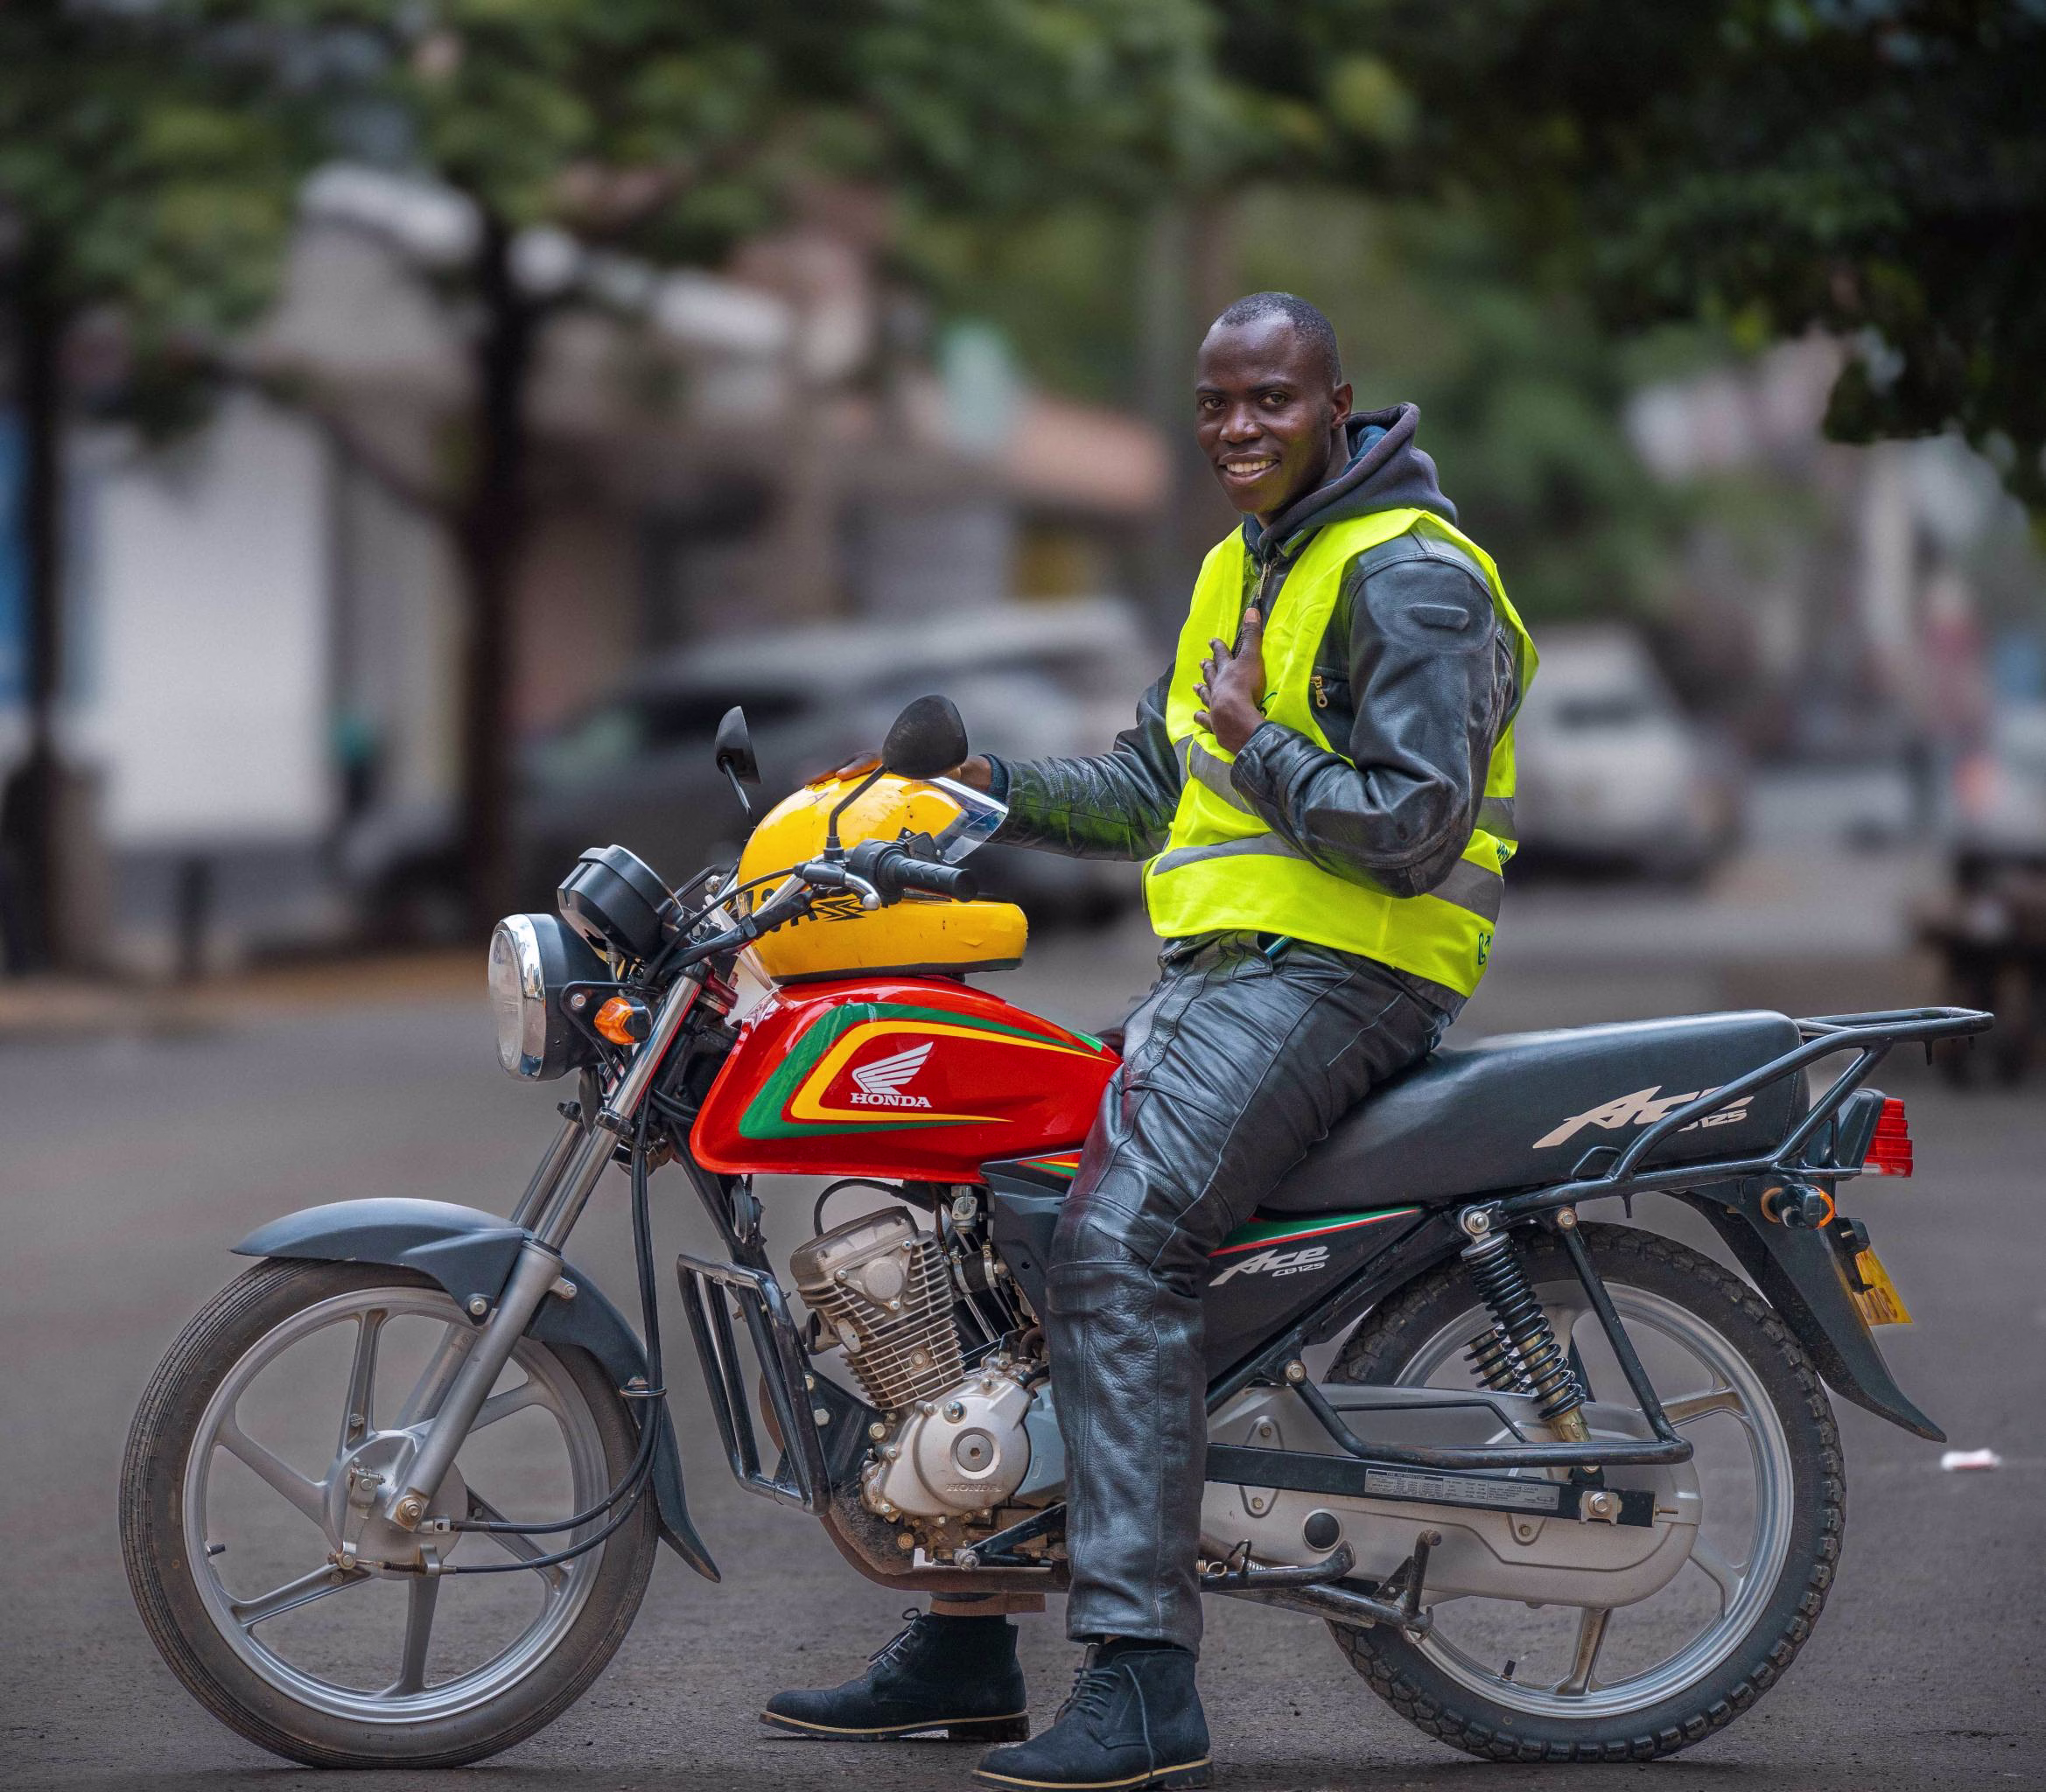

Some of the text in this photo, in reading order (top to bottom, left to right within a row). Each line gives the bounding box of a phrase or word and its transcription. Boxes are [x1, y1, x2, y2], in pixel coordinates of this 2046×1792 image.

[850, 1092, 933, 1109] HONDA
[1677, 1109, 1748, 1133] 125
[945, 1483, 1002, 1493] HONDA
